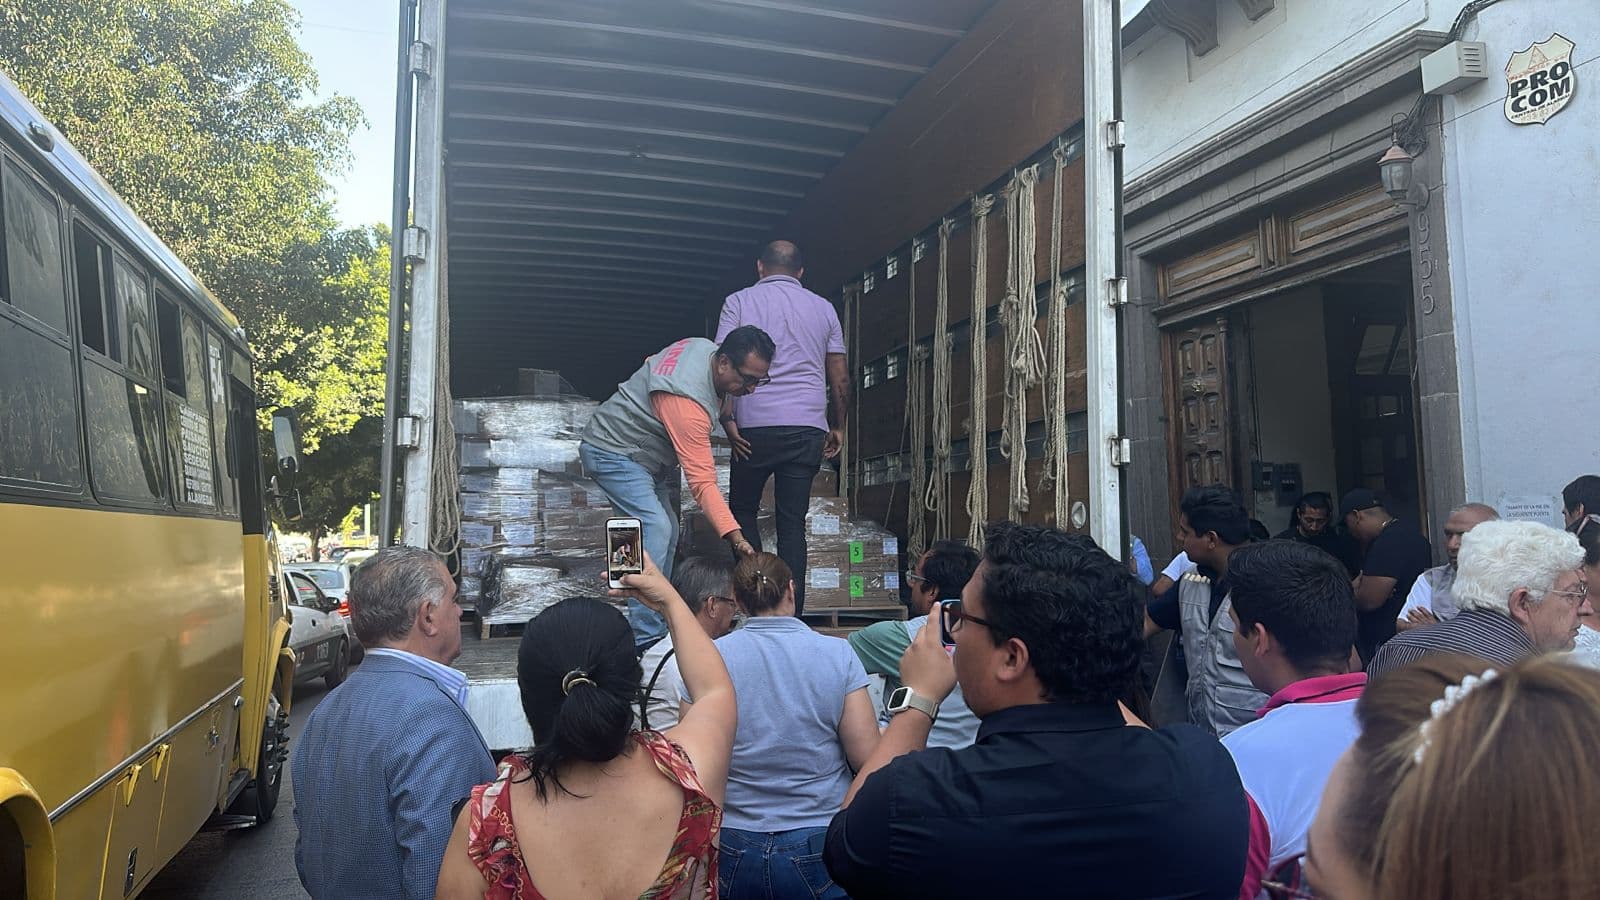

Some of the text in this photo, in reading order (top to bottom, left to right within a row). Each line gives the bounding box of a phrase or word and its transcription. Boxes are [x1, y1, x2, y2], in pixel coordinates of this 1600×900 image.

[1511, 61, 1569, 99] PRO
[1511, 77, 1570, 113] COM
[1417, 212, 1435, 315] 955
[854, 547, 859, 556] 5
[854, 581, 859, 589] 5
